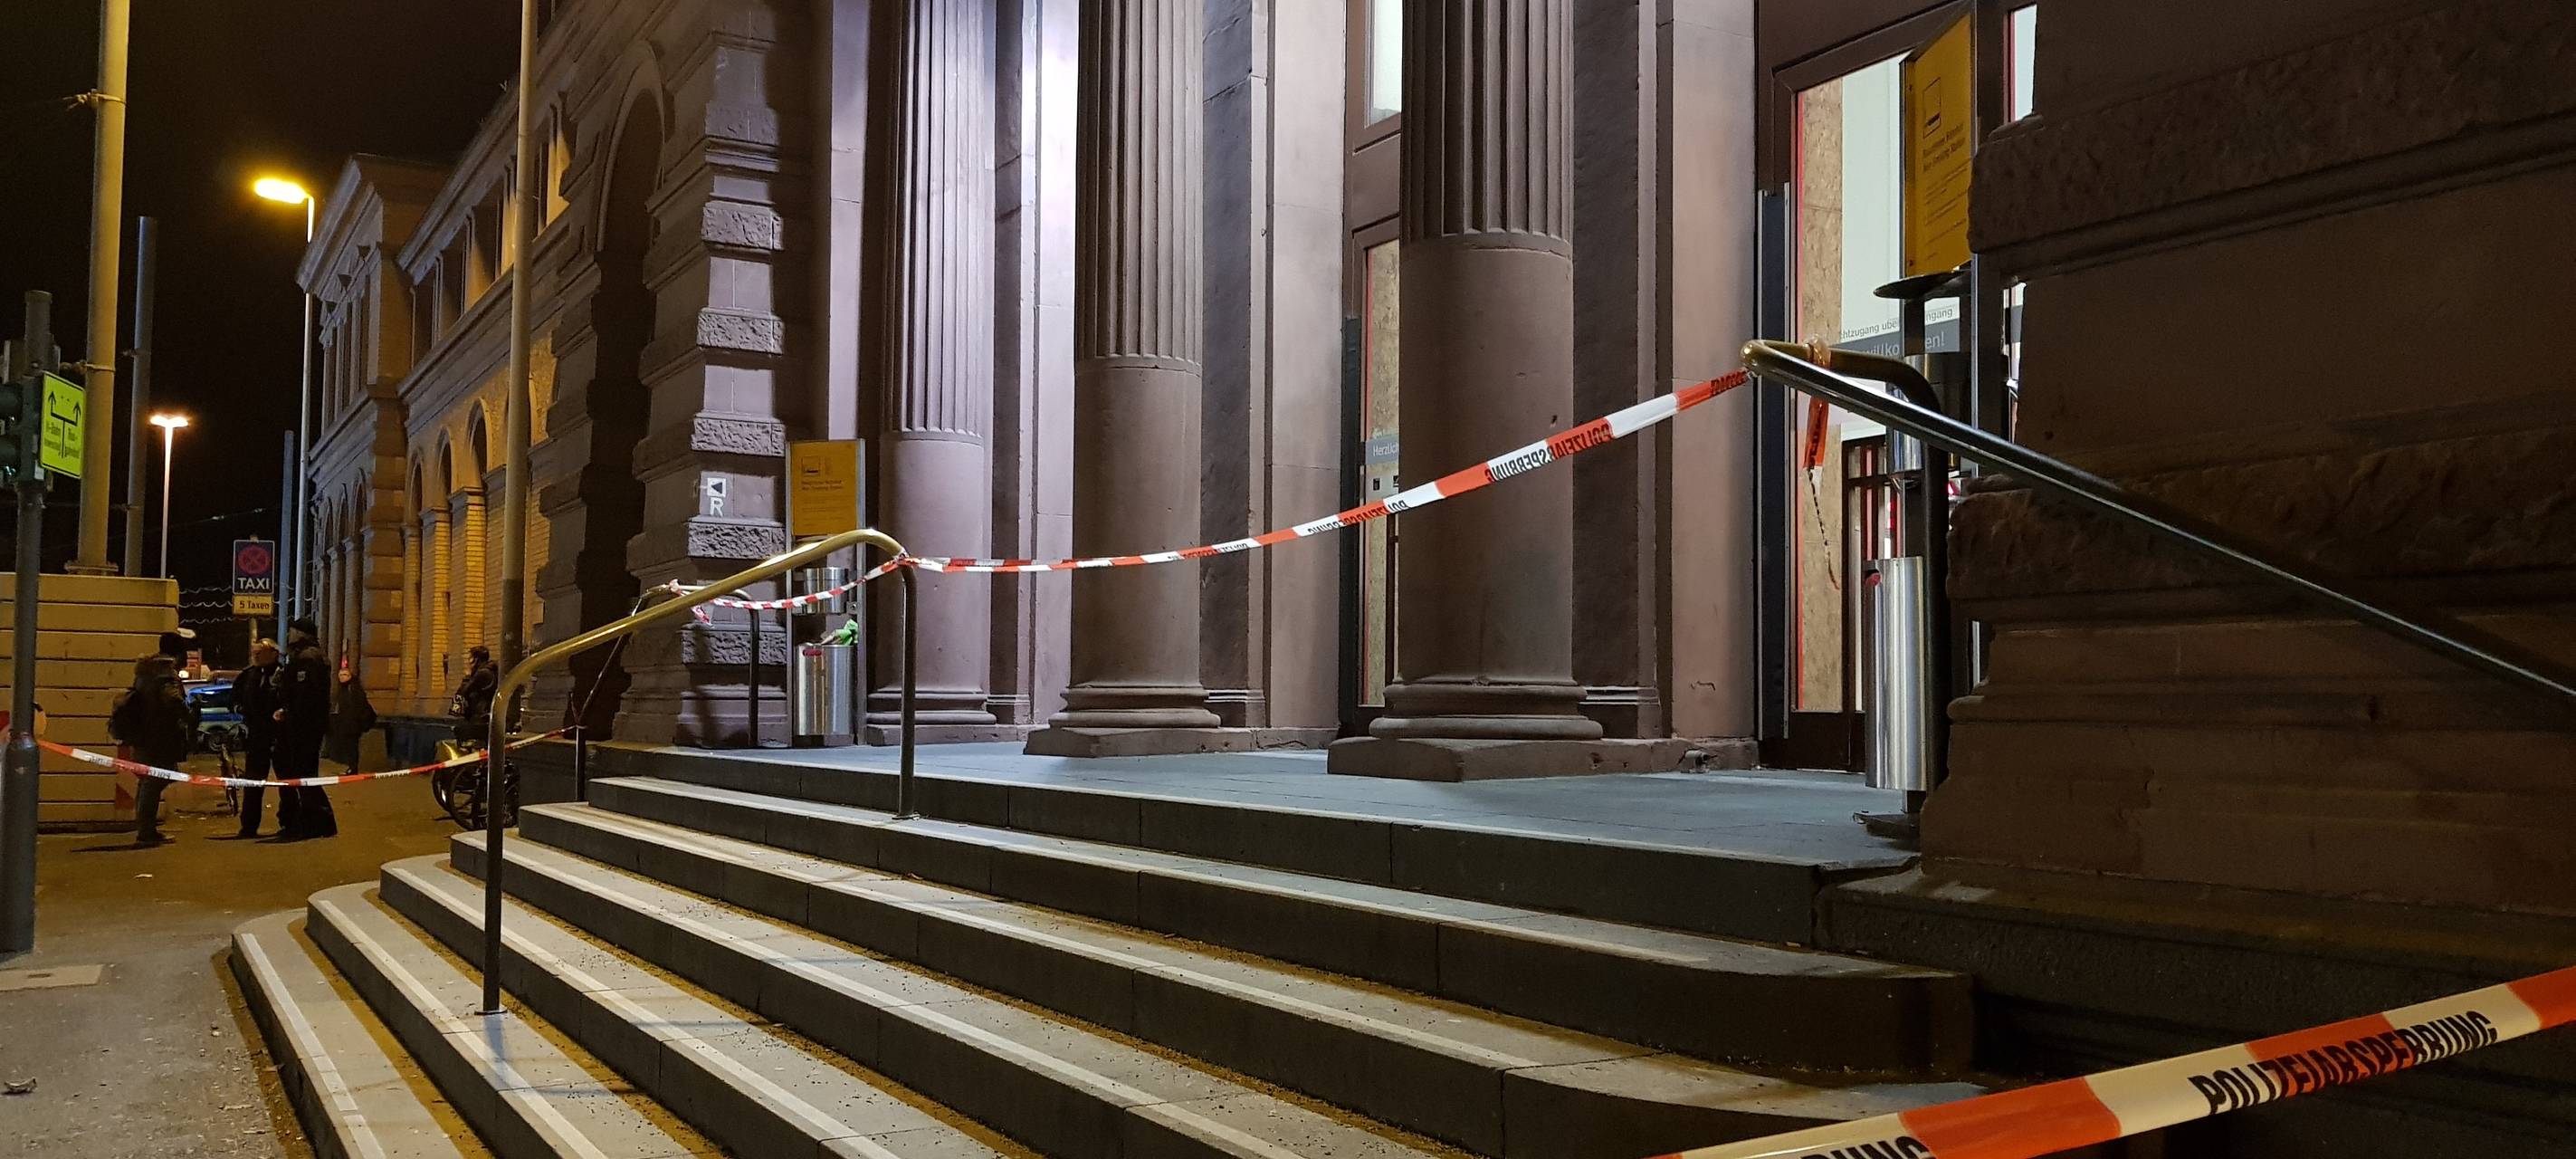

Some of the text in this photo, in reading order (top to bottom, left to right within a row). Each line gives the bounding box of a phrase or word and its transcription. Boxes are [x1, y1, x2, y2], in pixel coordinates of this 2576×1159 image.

[711, 497, 723, 517] R
[237, 577, 270, 589] TAXI
[240, 600, 245, 609] 5
[2188, 1010, 2498, 1116] POLIZEIABSPERRUNG
